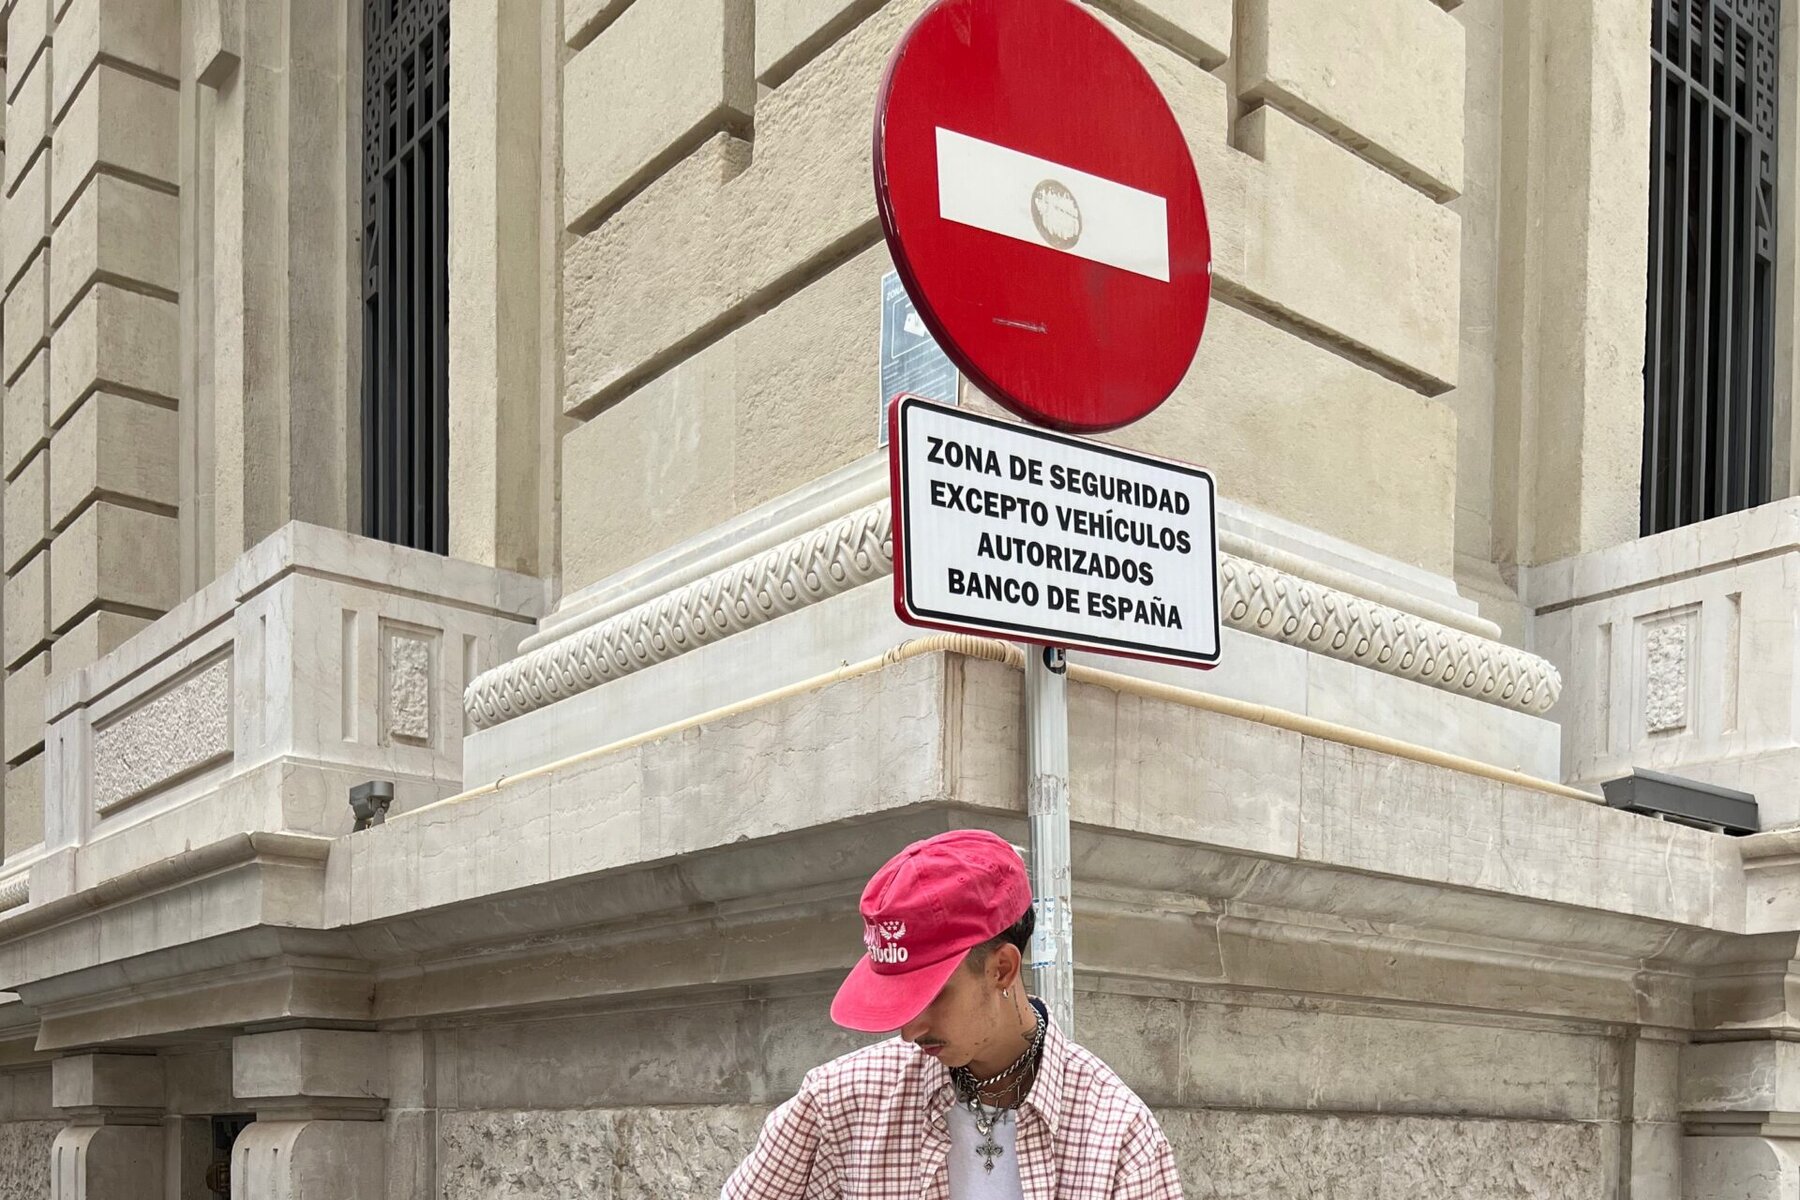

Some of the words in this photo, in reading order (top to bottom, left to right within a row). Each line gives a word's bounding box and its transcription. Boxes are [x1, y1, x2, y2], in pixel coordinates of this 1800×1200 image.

[927, 435, 1002, 478] ZONA
[1009, 454, 1043, 486] DE
[1049, 464, 1190, 516] SEGURIDAD
[929, 479, 1049, 527] EXCEPTO
[1055, 504, 1192, 555] VEHÍCULOS
[977, 531, 1154, 587] AUTORIZADOS
[947, 567, 1040, 607] BANCO
[1047, 584, 1081, 614] DE
[1087, 591, 1183, 630] ESPAÑA
